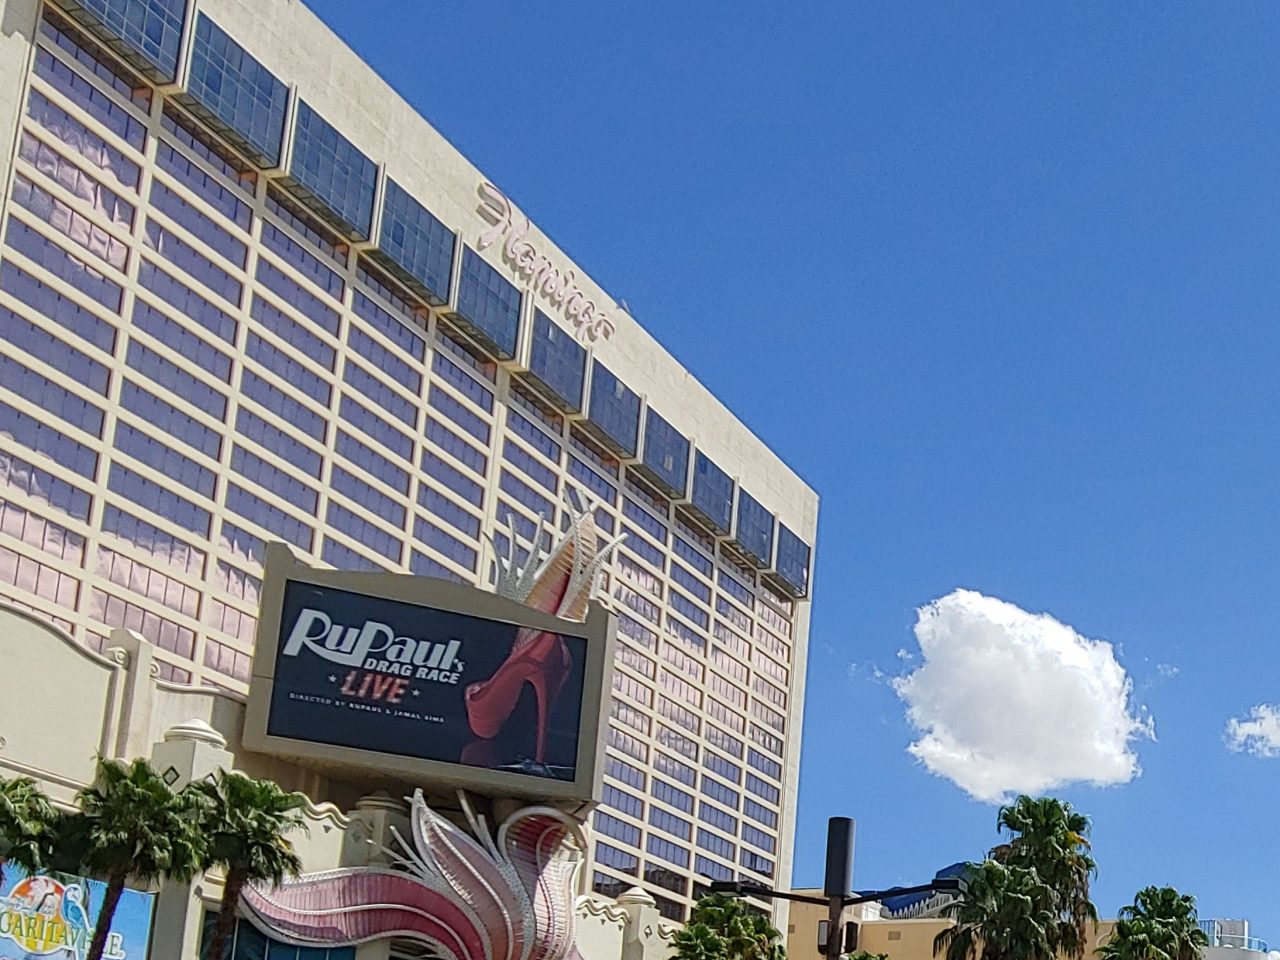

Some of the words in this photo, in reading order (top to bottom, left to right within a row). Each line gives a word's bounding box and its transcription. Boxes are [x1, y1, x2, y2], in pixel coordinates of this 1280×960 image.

[283, 608, 466, 673] RuPaul's
[340, 670, 411, 704] LIVE
[364, 658, 413, 677] DRAG
[415, 666, 461, 685] RACE
[289, 692, 331, 705] DIRECTED
[349, 703, 382, 713] RUPAUL
[394, 710, 421, 720] JAMAL
[424, 714, 445, 723] SIMS
